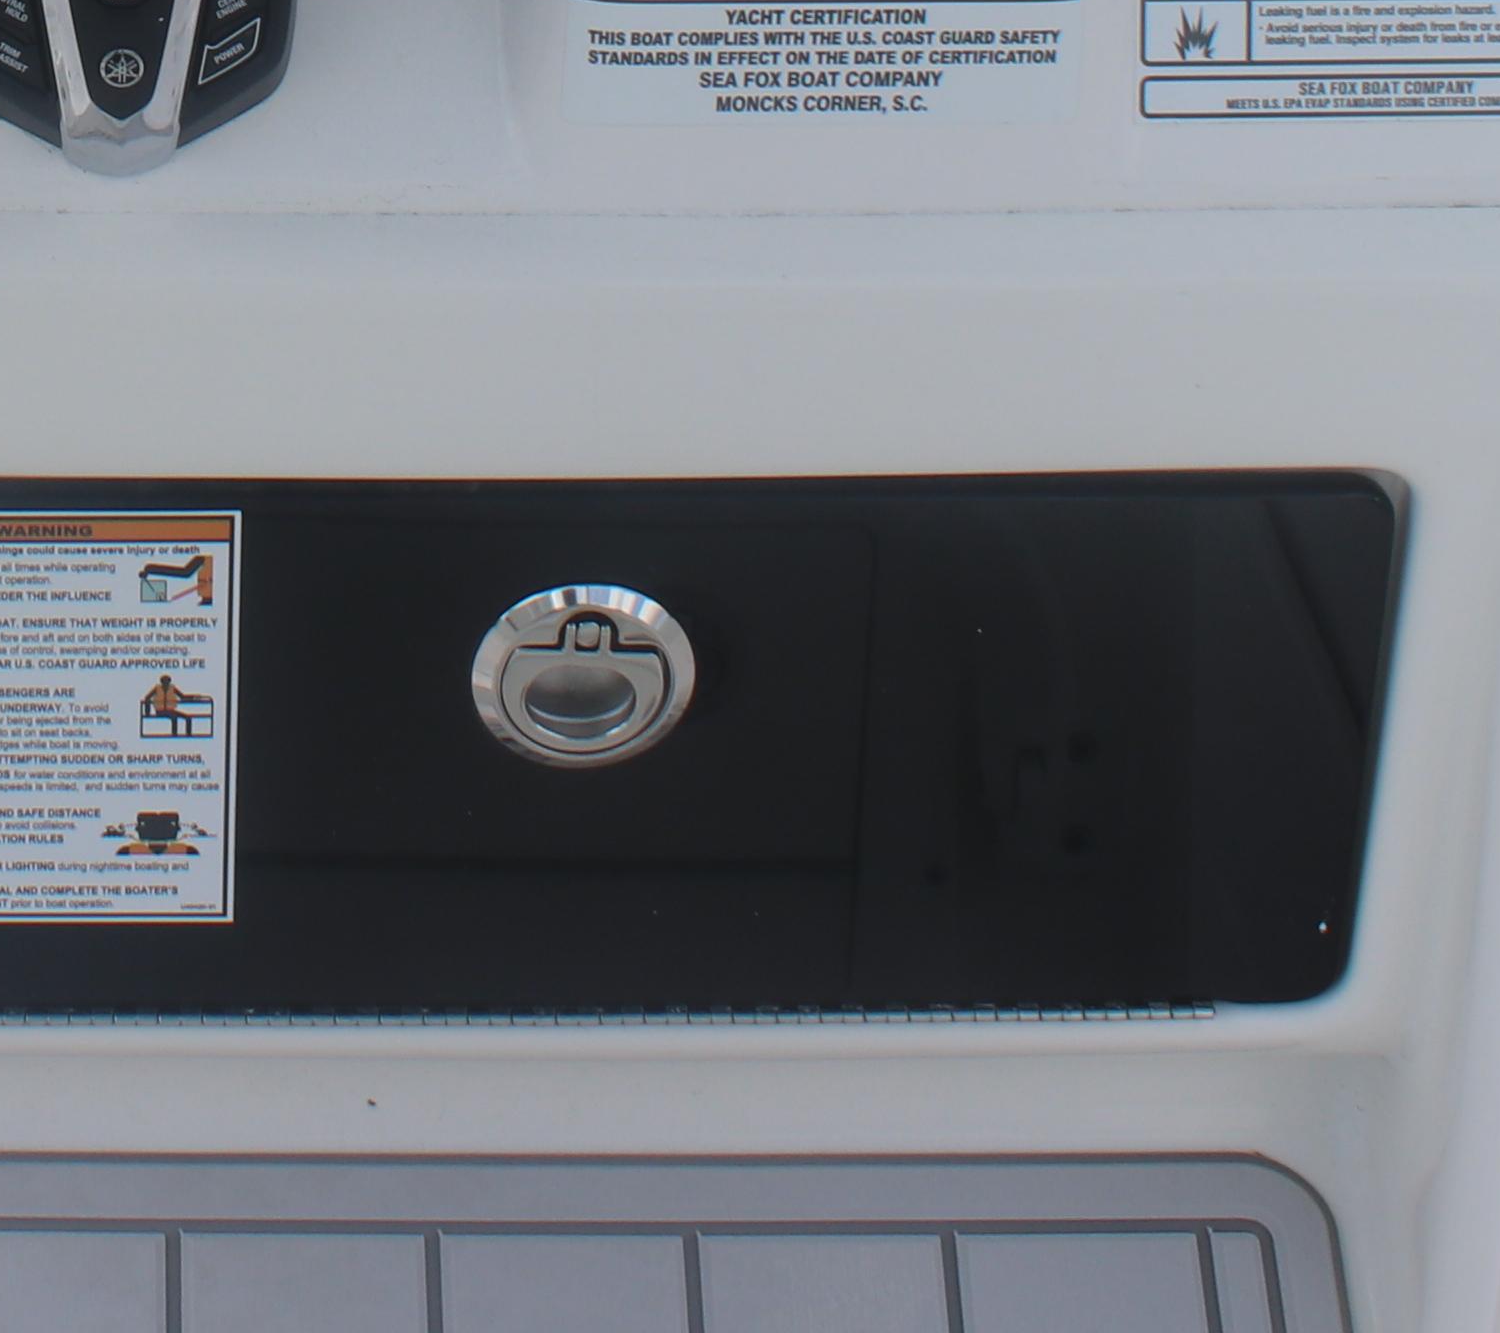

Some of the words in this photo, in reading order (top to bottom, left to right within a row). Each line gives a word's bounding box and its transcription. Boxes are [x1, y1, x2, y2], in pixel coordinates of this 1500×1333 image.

[5, 5, 29, 24] HOLD
[215, 0, 249, 20] ENGINE
[726, 9, 785, 25] YACHT
[790, 9, 926, 25] CERTIFICATION
[588, 29, 625, 46] THIS
[630, 32, 673, 46] BOAT
[677, 31, 759, 46] COMPLIES
[763, 31, 804, 45] WITH
[809, 31, 841, 45] THE
[846, 31, 876, 45] U.S.
[882, 31, 935, 45] COAST
[939, 30, 995, 44] GUARD
[1000, 30, 1059, 44] SAFETY
[0, 42, 21, 58] TRIM
[213, 42, 245, 65] POWER
[694, 51, 712, 65] IN
[717, 51, 780, 65] EFFECT
[785, 51, 810, 65] ON
[815, 51, 849, 64] THE
[854, 50, 896, 64] DATE
[901, 50, 923, 64] OF
[928, 49, 1056, 64] CERTIFICATION
[699, 71, 737, 88] SEA
[743, 71, 781, 88] FOX
[787, 71, 840, 87] BOAT
[845, 71, 942, 87] COMPANY
[1298, 82, 1327, 95] SEA
[1330, 82, 1357, 95] FOX
[1361, 81, 1399, 94] BOAT
[1403, 80, 1474, 94] COMPANY
[716, 95, 797, 112] MONCKS
[803, 95, 886, 113] CORNER,
[892, 95, 927, 111] S.C.
[1262, 98, 1281, 109] U.S.
[27, 591, 46, 601] THE
[50, 591, 111, 601] INFLUENCE
